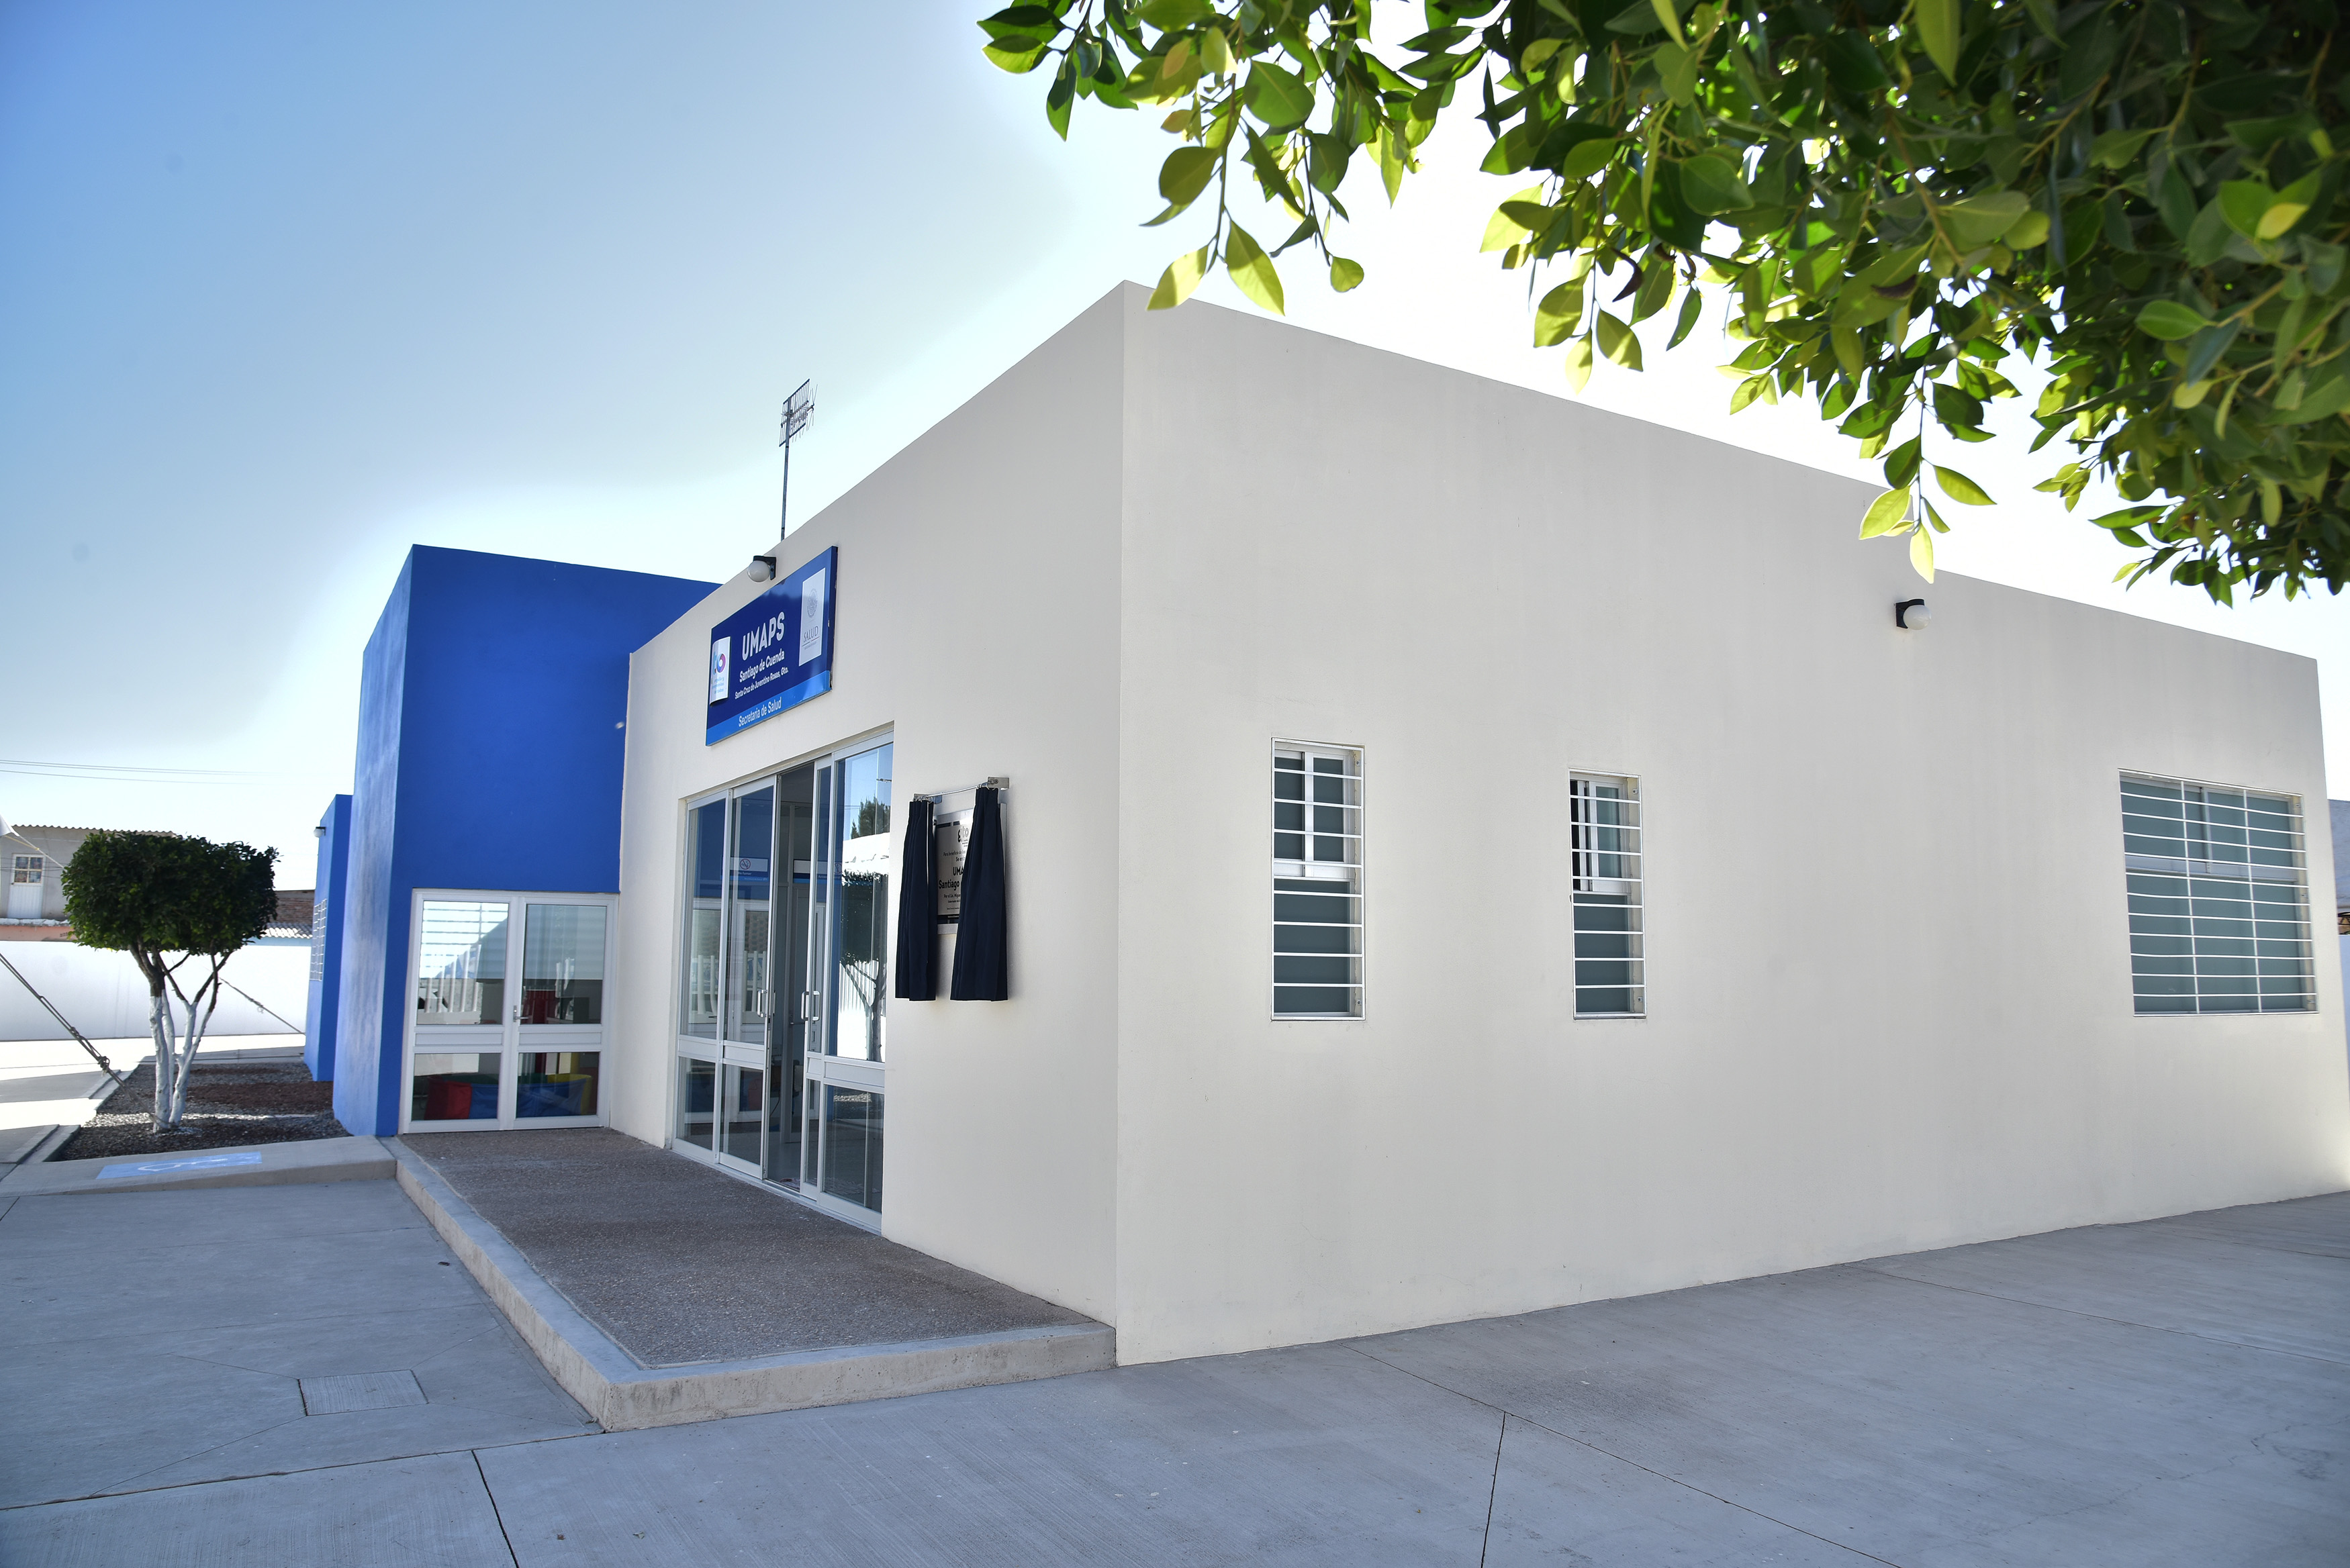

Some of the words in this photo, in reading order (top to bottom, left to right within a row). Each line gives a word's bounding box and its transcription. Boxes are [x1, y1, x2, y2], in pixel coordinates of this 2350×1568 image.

[742, 611, 785, 660] UMAPS
[803, 626, 818, 642] SALUD
[739, 666, 759, 683] Santiago
[759, 658, 765, 672] de
[765, 648, 785, 668] Cuenda
[735, 690, 743, 699] Santa
[750, 683, 755, 691] de
[754, 676, 770, 689] Juventino
[769, 671, 781, 681] Rosas,
[780, 667, 789, 675] Gto.
[761, 704, 767, 716] de
[767, 696, 782, 714] Salud
[939, 879, 960, 891] Santiago
